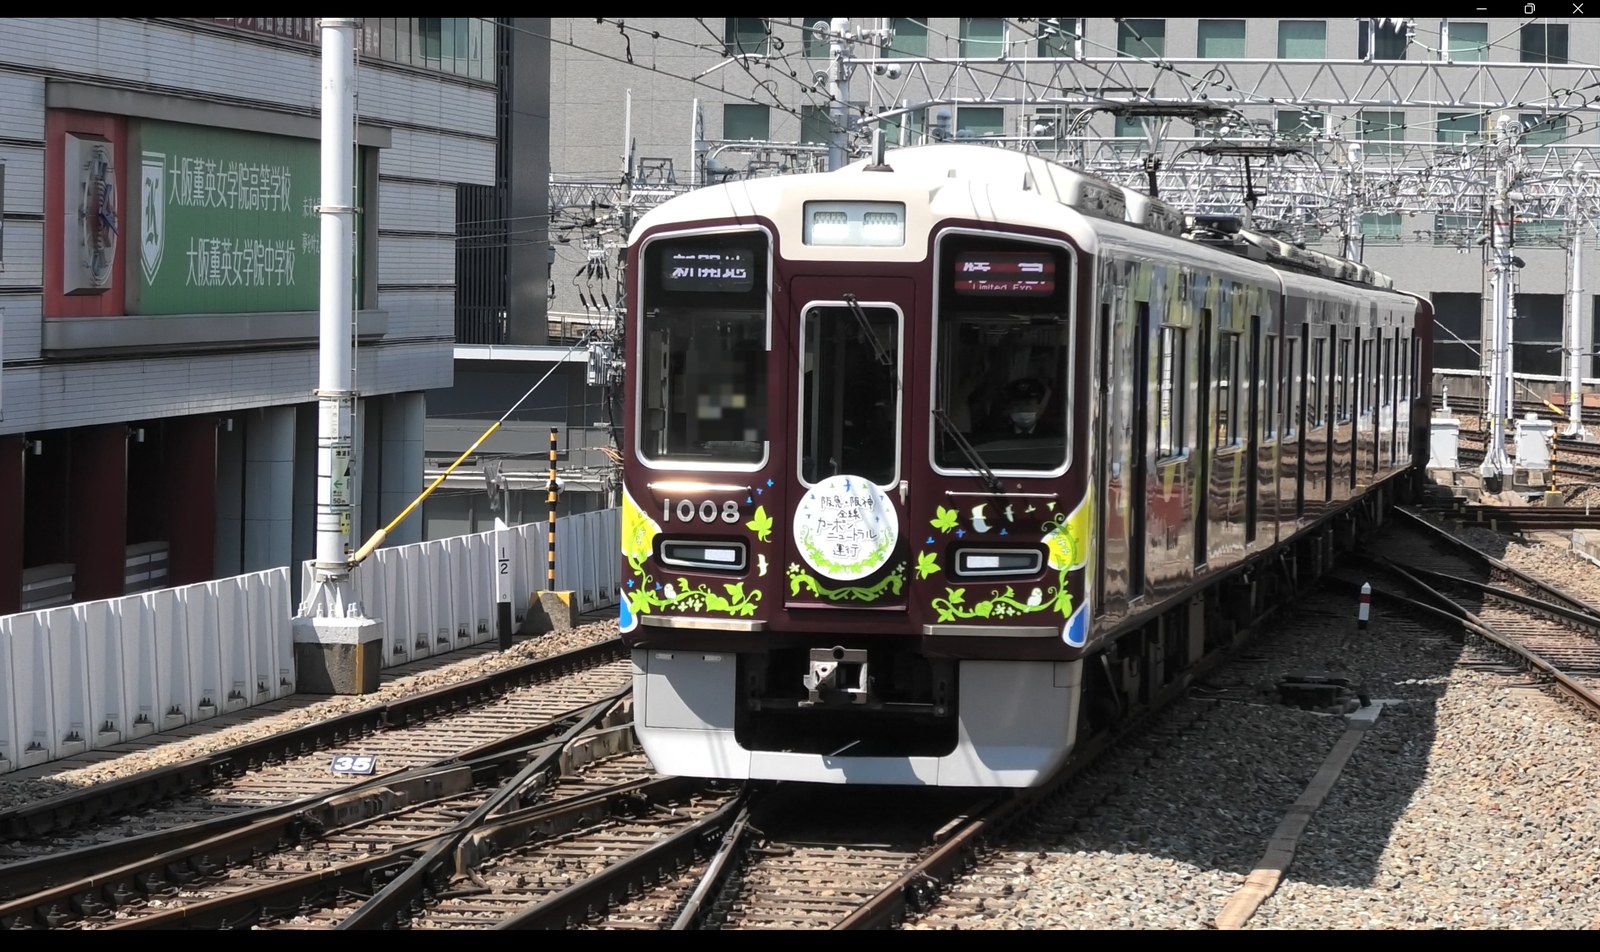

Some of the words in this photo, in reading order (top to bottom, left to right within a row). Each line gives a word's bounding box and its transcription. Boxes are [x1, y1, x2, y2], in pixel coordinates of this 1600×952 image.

[168, 155, 291, 212] 大阪薫英女学院高等学校
[186, 237, 295, 286] 大阪薫英女学院中学校
[663, 498, 740, 524] 1008
[817, 517, 854, 533] カーボン
[827, 528, 877, 541] ニュートラル
[833, 543, 859, 558] 運行
[334, 757, 372, 771] 35
